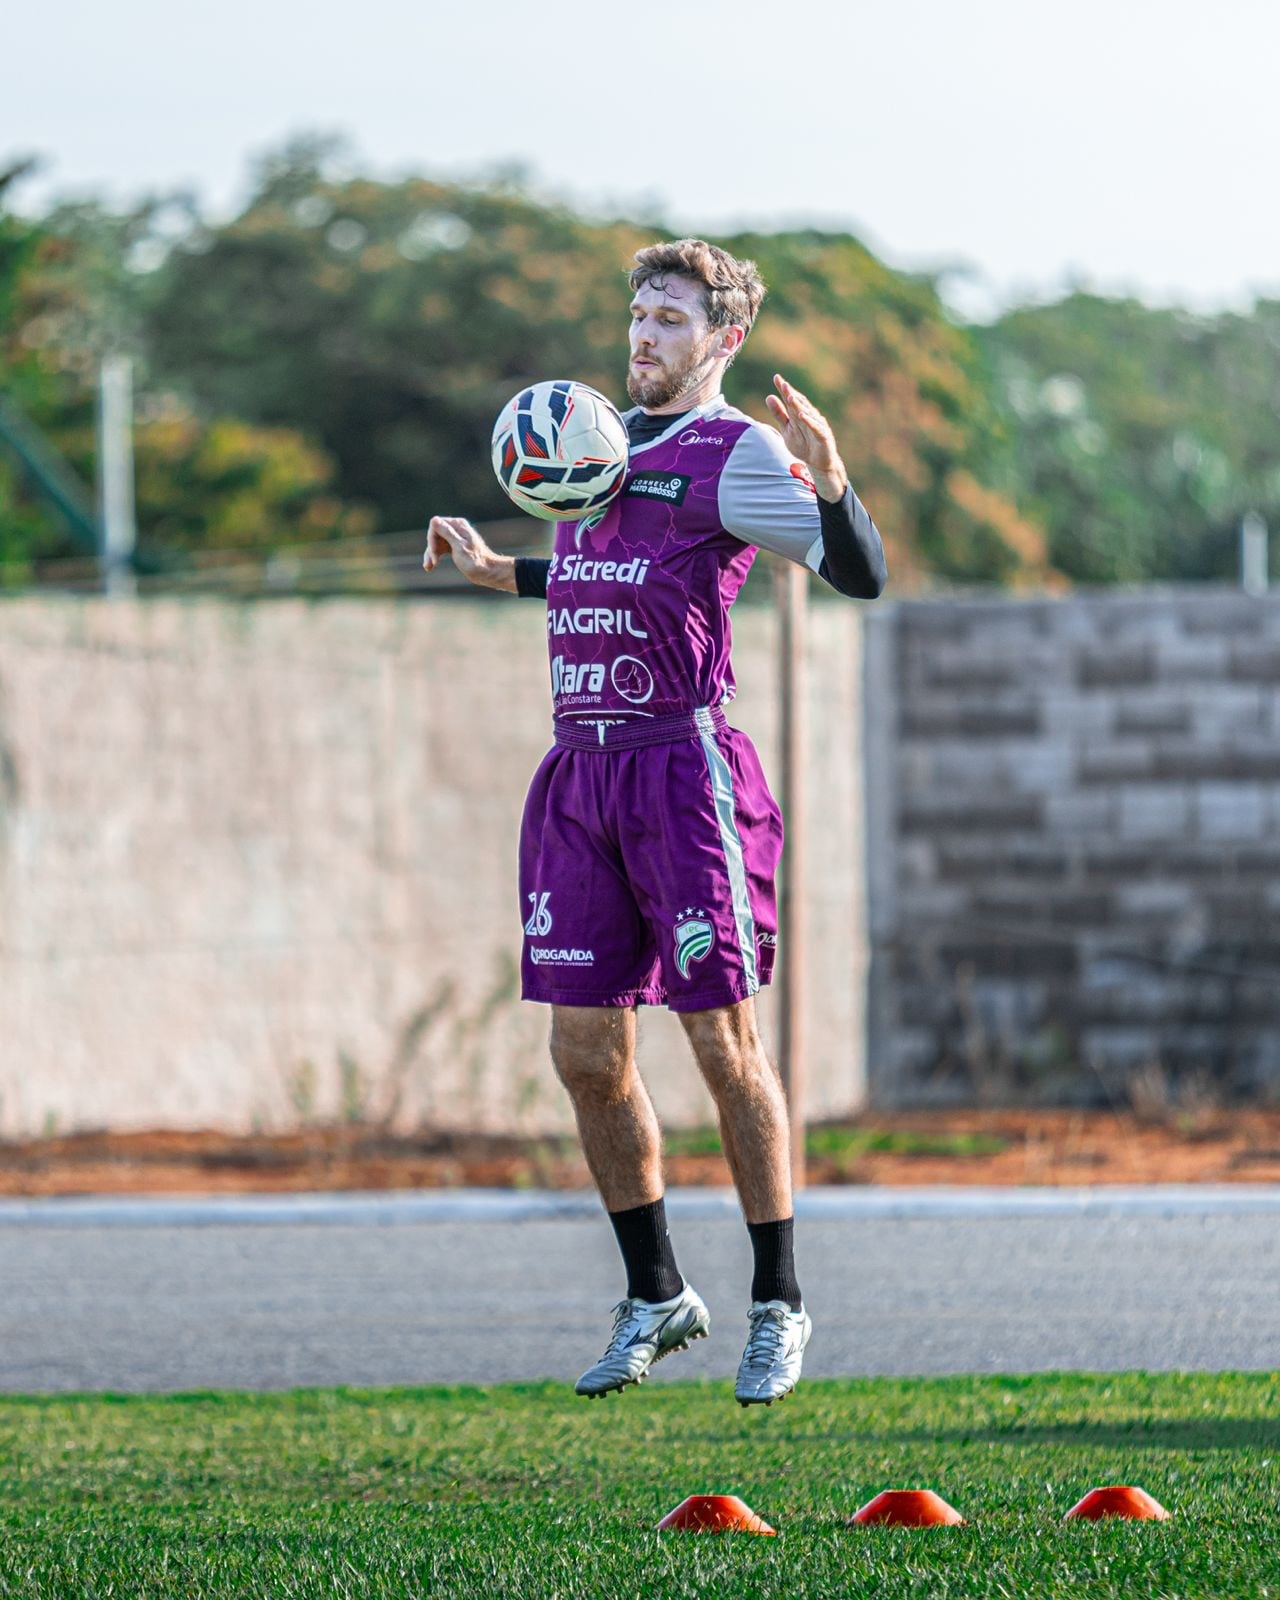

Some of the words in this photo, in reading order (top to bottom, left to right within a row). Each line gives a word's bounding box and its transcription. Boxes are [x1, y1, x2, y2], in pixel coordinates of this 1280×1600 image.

[648, 486, 677, 498] GROSSO
[558, 554, 650, 585] Sicredi
[525, 892, 552, 936] 26
